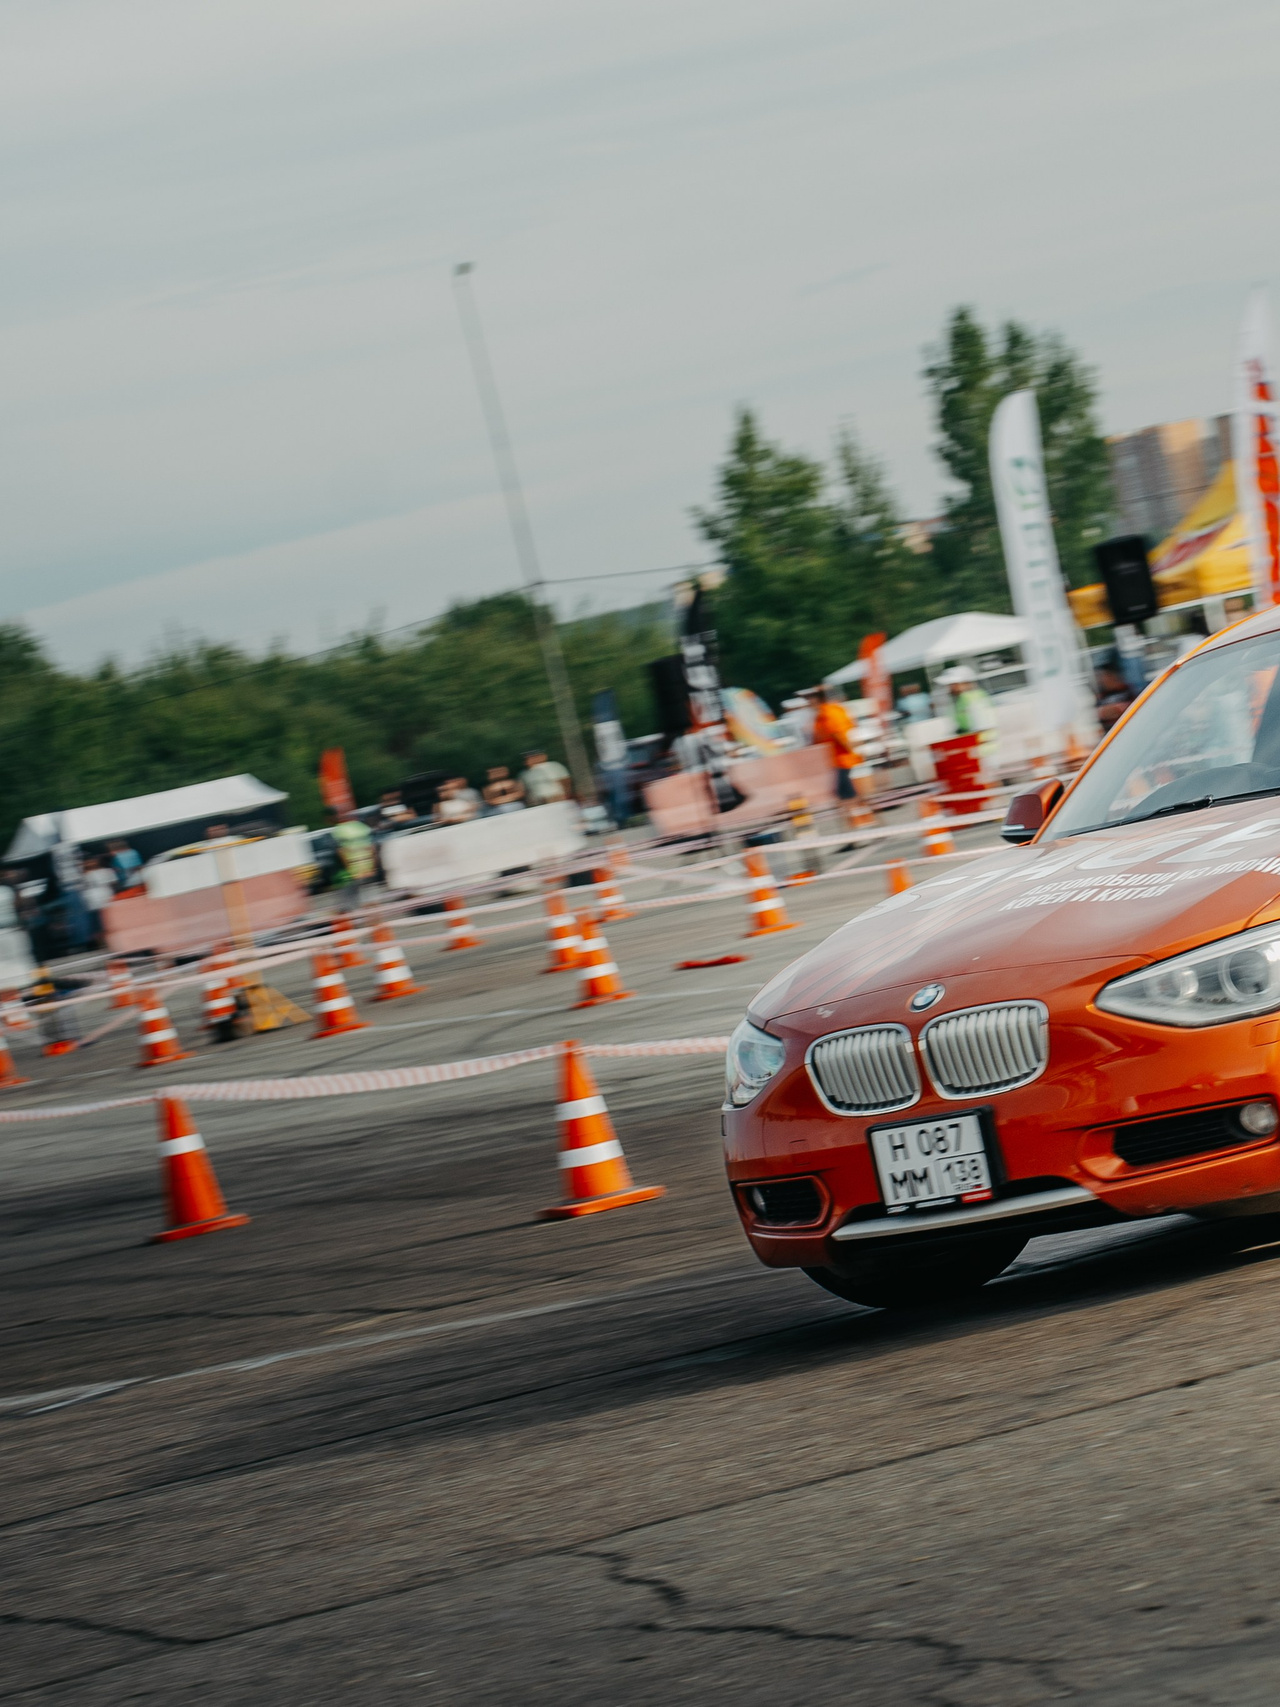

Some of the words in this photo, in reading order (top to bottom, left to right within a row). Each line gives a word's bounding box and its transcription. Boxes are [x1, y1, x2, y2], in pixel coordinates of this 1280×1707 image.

[1019, 871, 1179, 898] АВТОМОБИЛИ
[1172, 866, 1212, 881] ИЗ
[1070, 888, 1100, 902] И
[1090, 883, 1176, 902] КИТАЯ
[887, 1132, 910, 1162] Н
[917, 1123, 961, 1156] 087
[890, 1166, 934, 1200] ММ
[943, 1159, 982, 1184] 138
